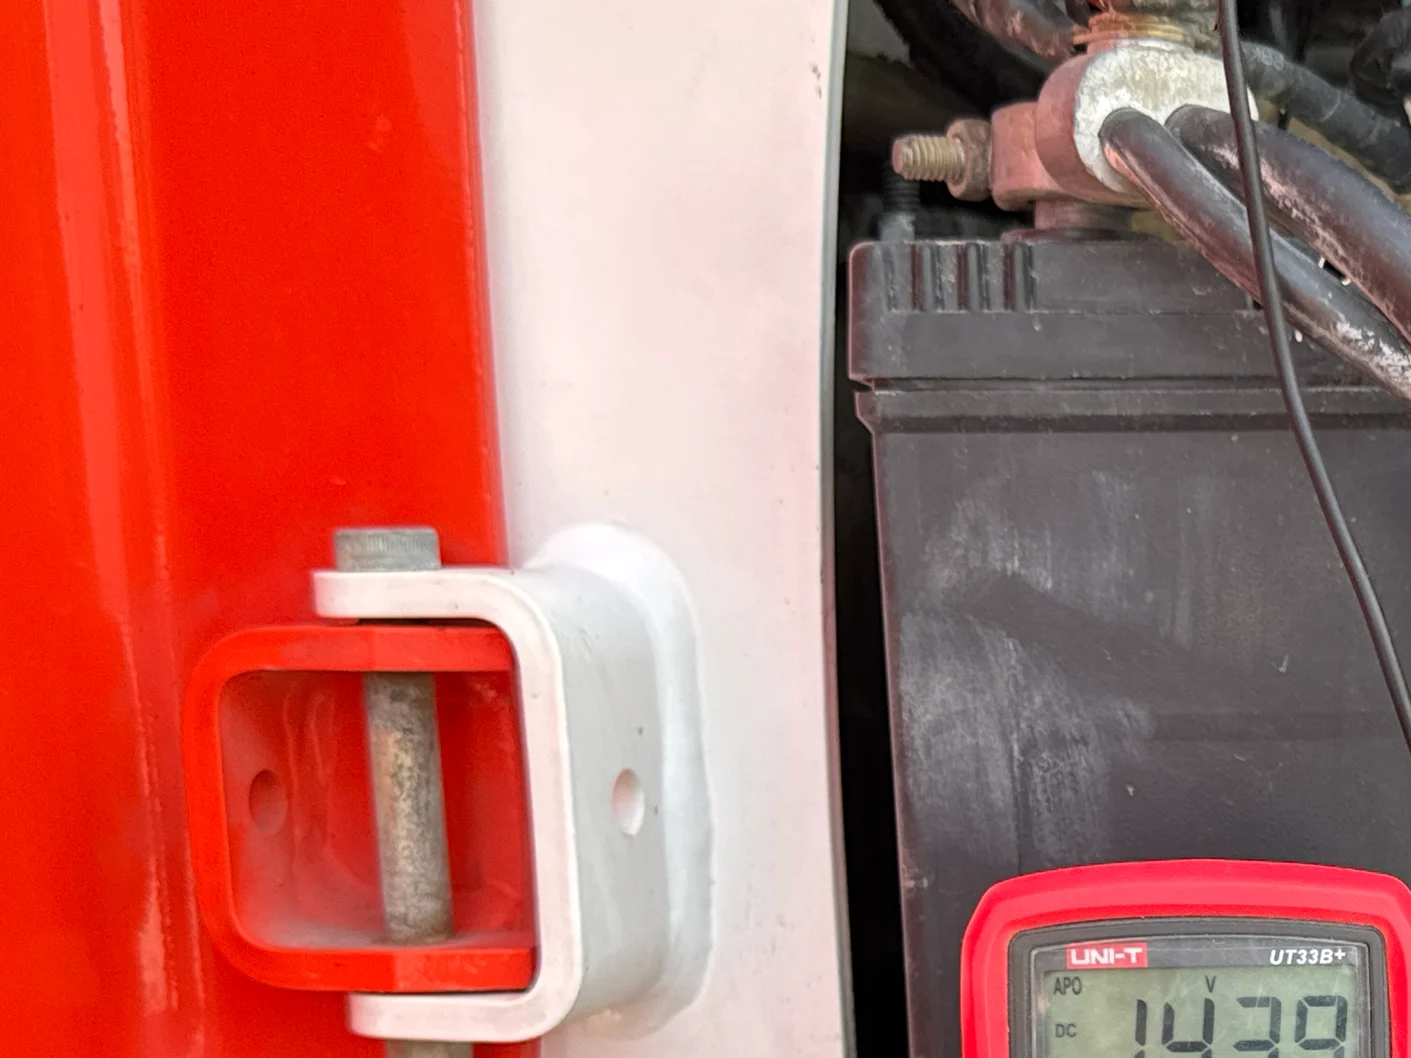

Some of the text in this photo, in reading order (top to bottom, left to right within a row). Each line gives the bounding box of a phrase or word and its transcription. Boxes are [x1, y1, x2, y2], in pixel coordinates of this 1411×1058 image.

[1070, 947, 1142, 965] UNI-T
[1269, 948, 1346, 966] UT33B+
[1053, 976, 1082, 995] APO
[1204, 976, 1216, 993] V
[1055, 1023, 1076, 1038] DC
